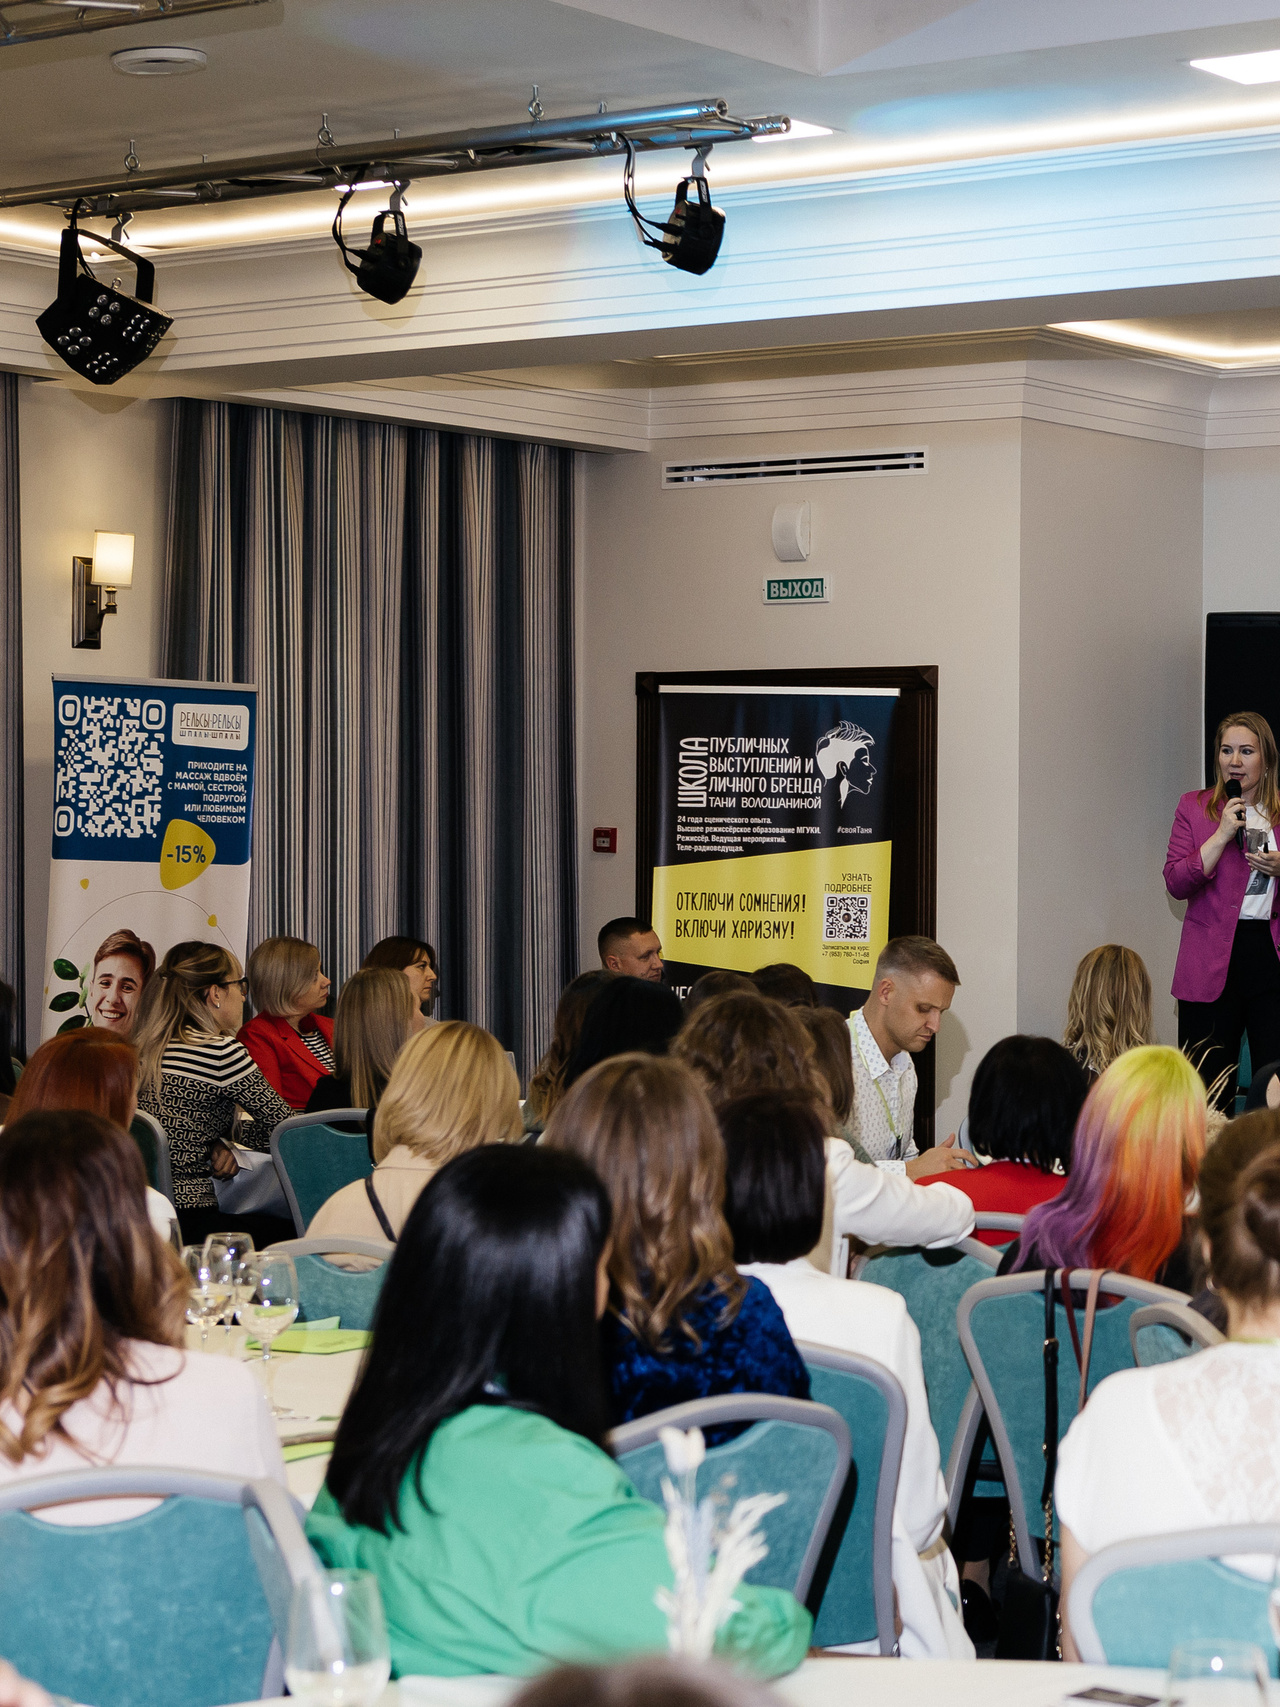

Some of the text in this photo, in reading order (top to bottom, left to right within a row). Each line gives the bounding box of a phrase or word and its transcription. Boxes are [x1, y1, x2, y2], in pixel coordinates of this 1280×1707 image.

[770, 580, 823, 598] ВЫХОД
[709, 736, 790, 754] ПУБЛИЧНЫХ
[187, 761, 248, 772] ПРИХОДИТЕ НА
[708, 755, 814, 774] ВЫСТУПЛЕНИЙ И
[175, 771, 248, 782] МАССАЖ ВДВОЁМ
[677, 737, 709, 808] ШКОЛА
[167, 781, 247, 794] С МАМОЙ, СЕСТРОЙ,
[708, 776, 822, 795] ЛИЧНОГО БРЕНДА
[203, 793, 247, 803] ПОДРУГОЙ
[708, 795, 822, 809] ТАНИ ВОЛОШАНИНОЙ
[184, 804, 246, 813] ИЛИ ЛЮБИМЫМ
[197, 815, 246, 824] ЧЕЛОВЕКОМ
[677, 815, 686, 823] 24
[687, 816, 703, 824] года
[676, 824, 704, 832] Высшее
[752, 825, 796, 834] образование
[837, 825, 873, 834] #свояТаня
[711, 834, 742, 844] Ведущая
[166, 844, 207, 864] -15%
[841, 872, 873, 882] УЗНАТЬ
[824, 883, 872, 893] ПОДРОБНЕЕ
[676, 891, 806, 913] ОТКЛЮЧИ СОМНЕНИЯ!
[675, 919, 795, 940] ВКЛЮЧИ ХАРИЗМУ!
